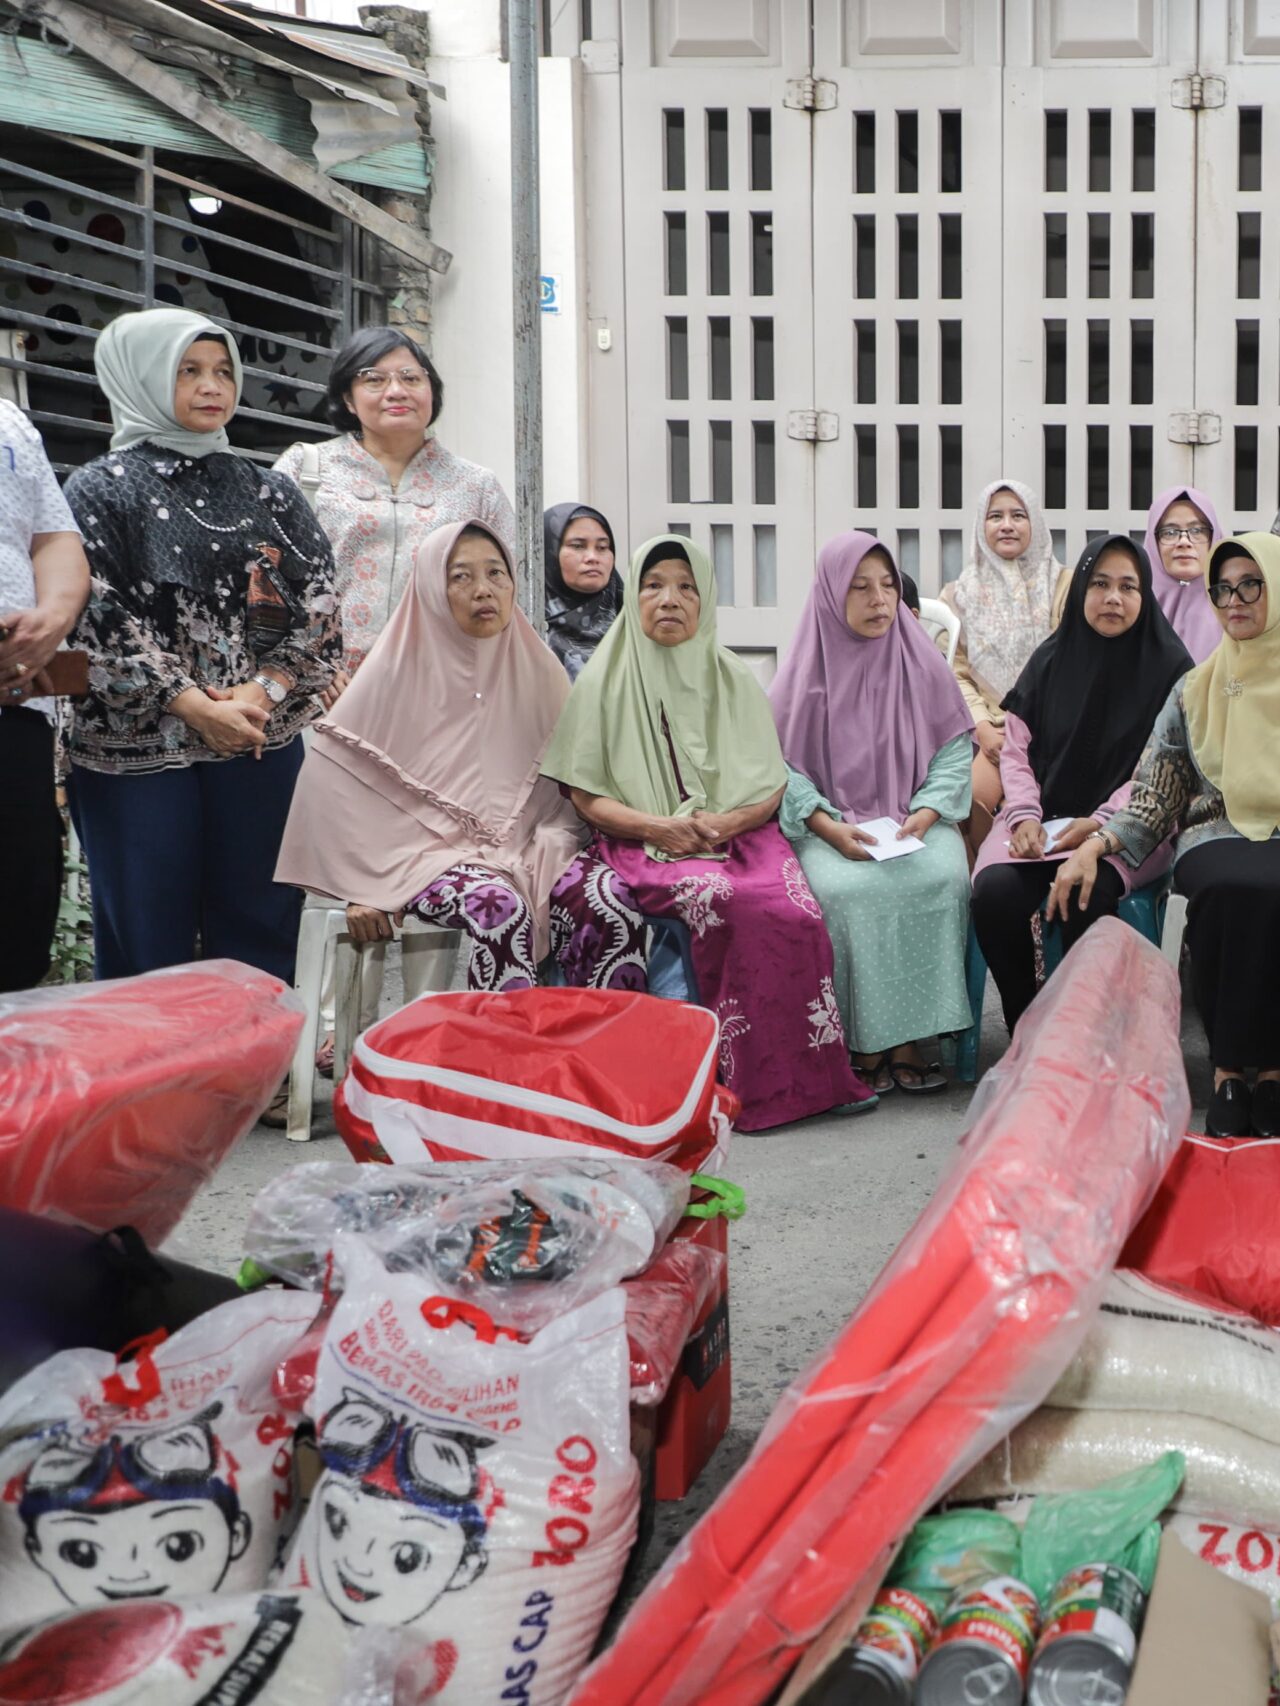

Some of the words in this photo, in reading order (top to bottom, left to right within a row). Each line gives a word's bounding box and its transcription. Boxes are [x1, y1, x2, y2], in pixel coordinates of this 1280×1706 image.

[340, 1331, 407, 1388] BERAS
[531, 1434, 597, 1567] ZORO
[513, 1591, 554, 1653] CAP
